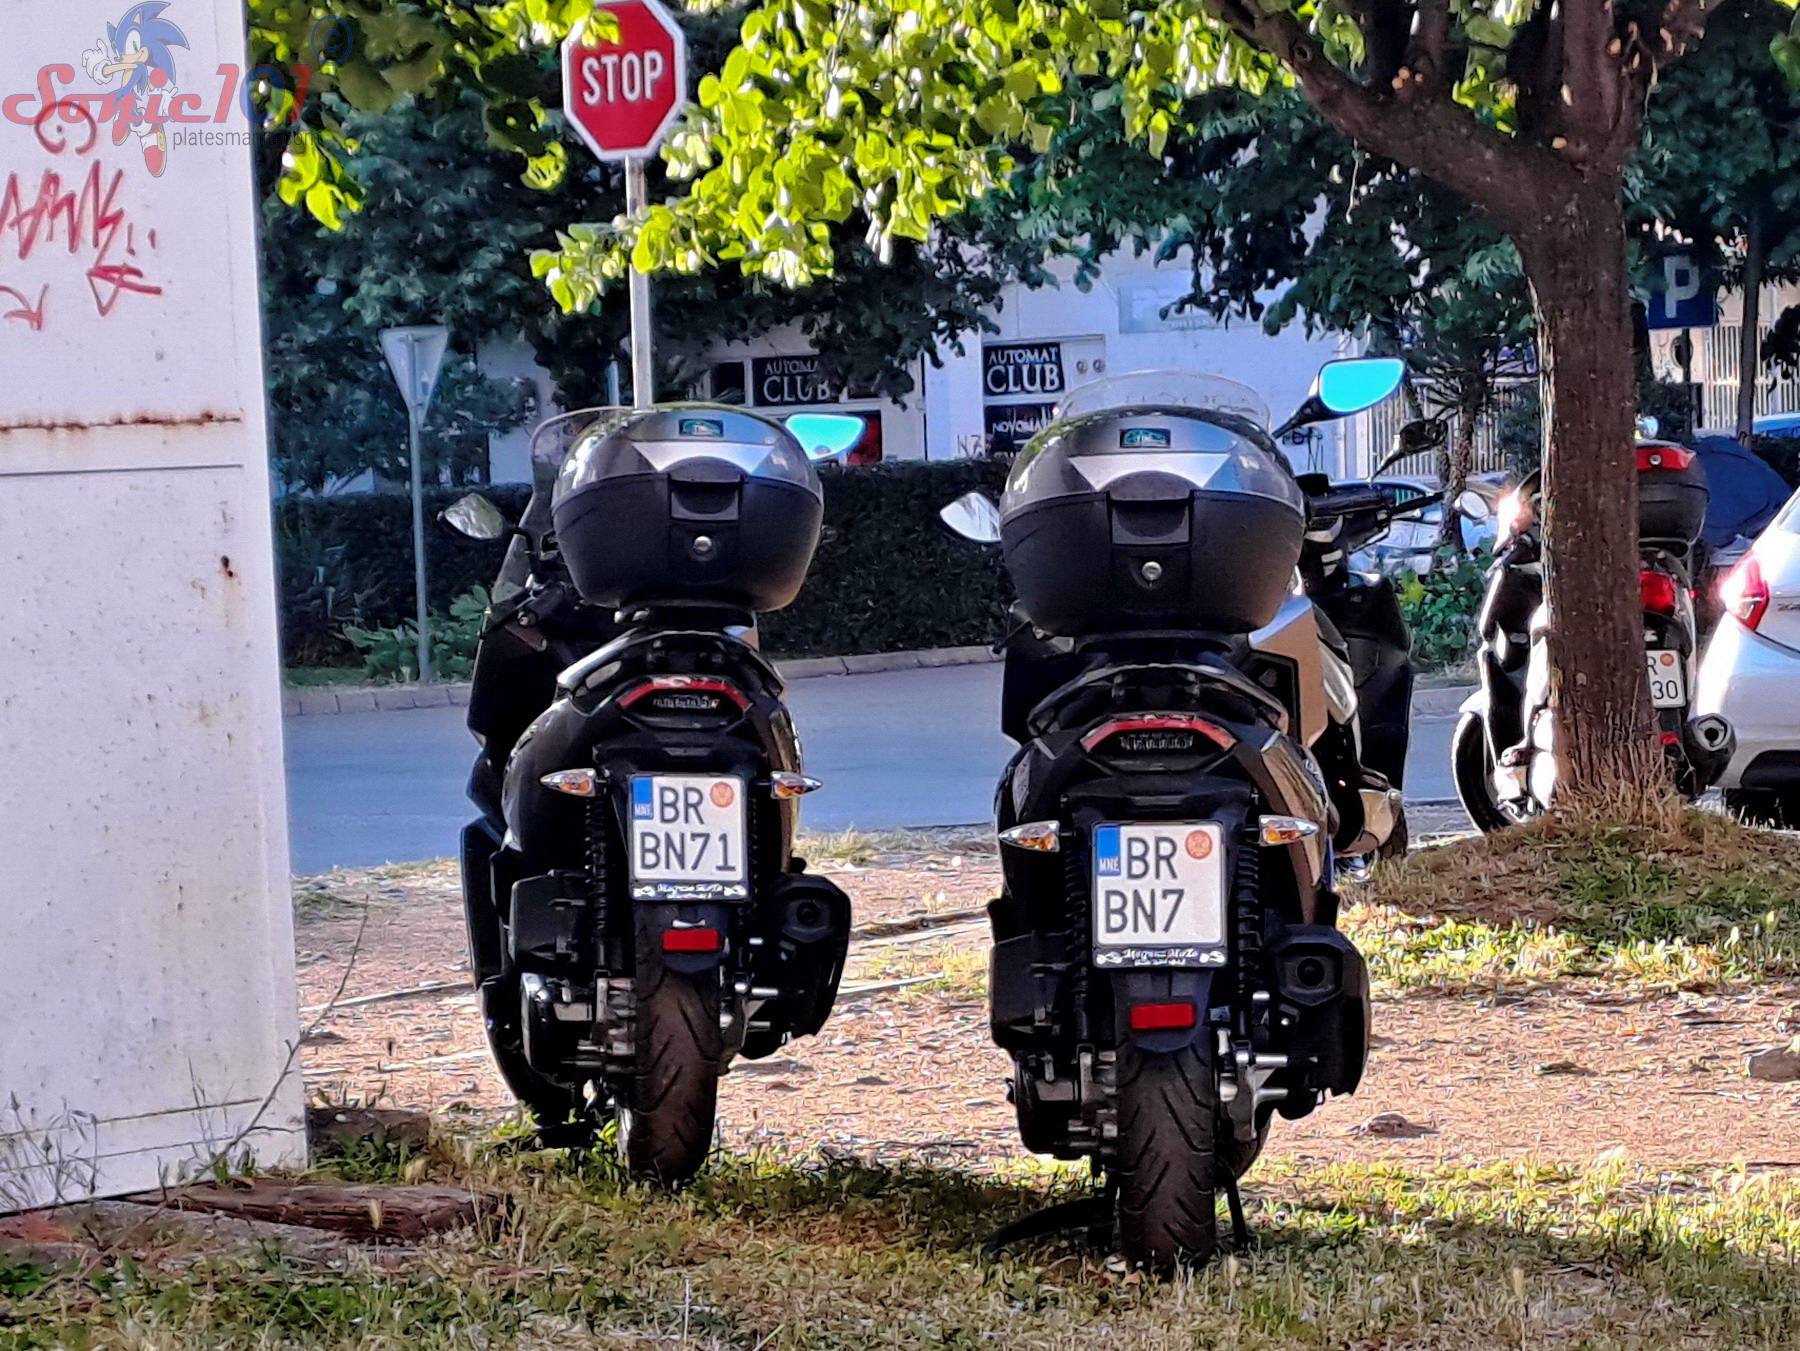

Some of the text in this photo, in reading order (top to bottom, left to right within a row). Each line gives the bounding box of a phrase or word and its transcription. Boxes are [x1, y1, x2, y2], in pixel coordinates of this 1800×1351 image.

[582, 50, 663, 106] STOP
[1664, 255, 1700, 318] P
[989, 347, 1058, 365] AUTOMAT
[763, 376, 831, 402] CLUB
[987, 363, 1060, 393] CLUB
[1652, 680, 1679, 700] 30
[659, 786, 705, 825] BR
[639, 831, 736, 872] BN71
[1127, 836, 1178, 880] BR
[1104, 888, 1185, 934] BN7
